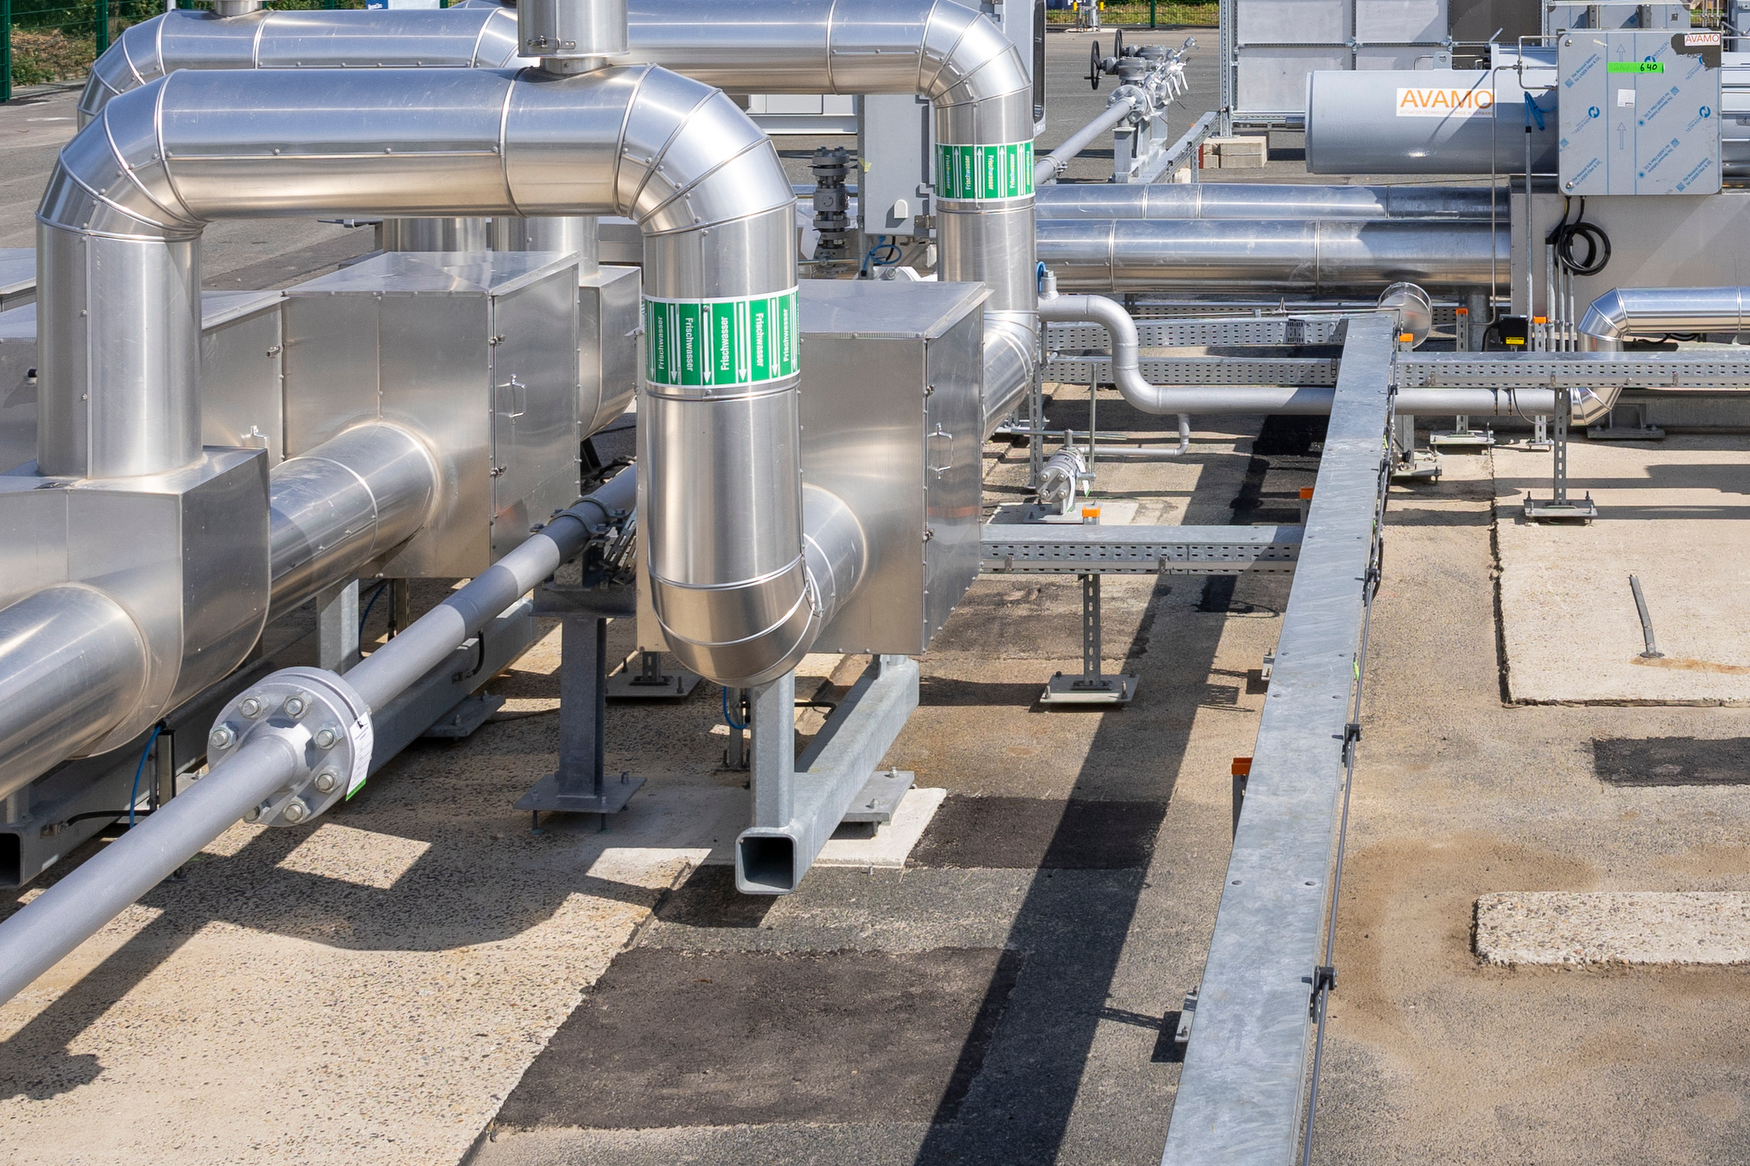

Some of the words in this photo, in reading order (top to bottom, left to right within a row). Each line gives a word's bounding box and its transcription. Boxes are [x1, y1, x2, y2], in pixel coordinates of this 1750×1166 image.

[1685, 34, 1720, 43] AVAMO
[1640, 63, 1658, 72] 640
[1400, 90, 1494, 109] AVAMO
[685, 318, 694, 372] Frischwasser
[720, 316, 730, 371] Frischwasser
[756, 313, 764, 367] Frischwasser
